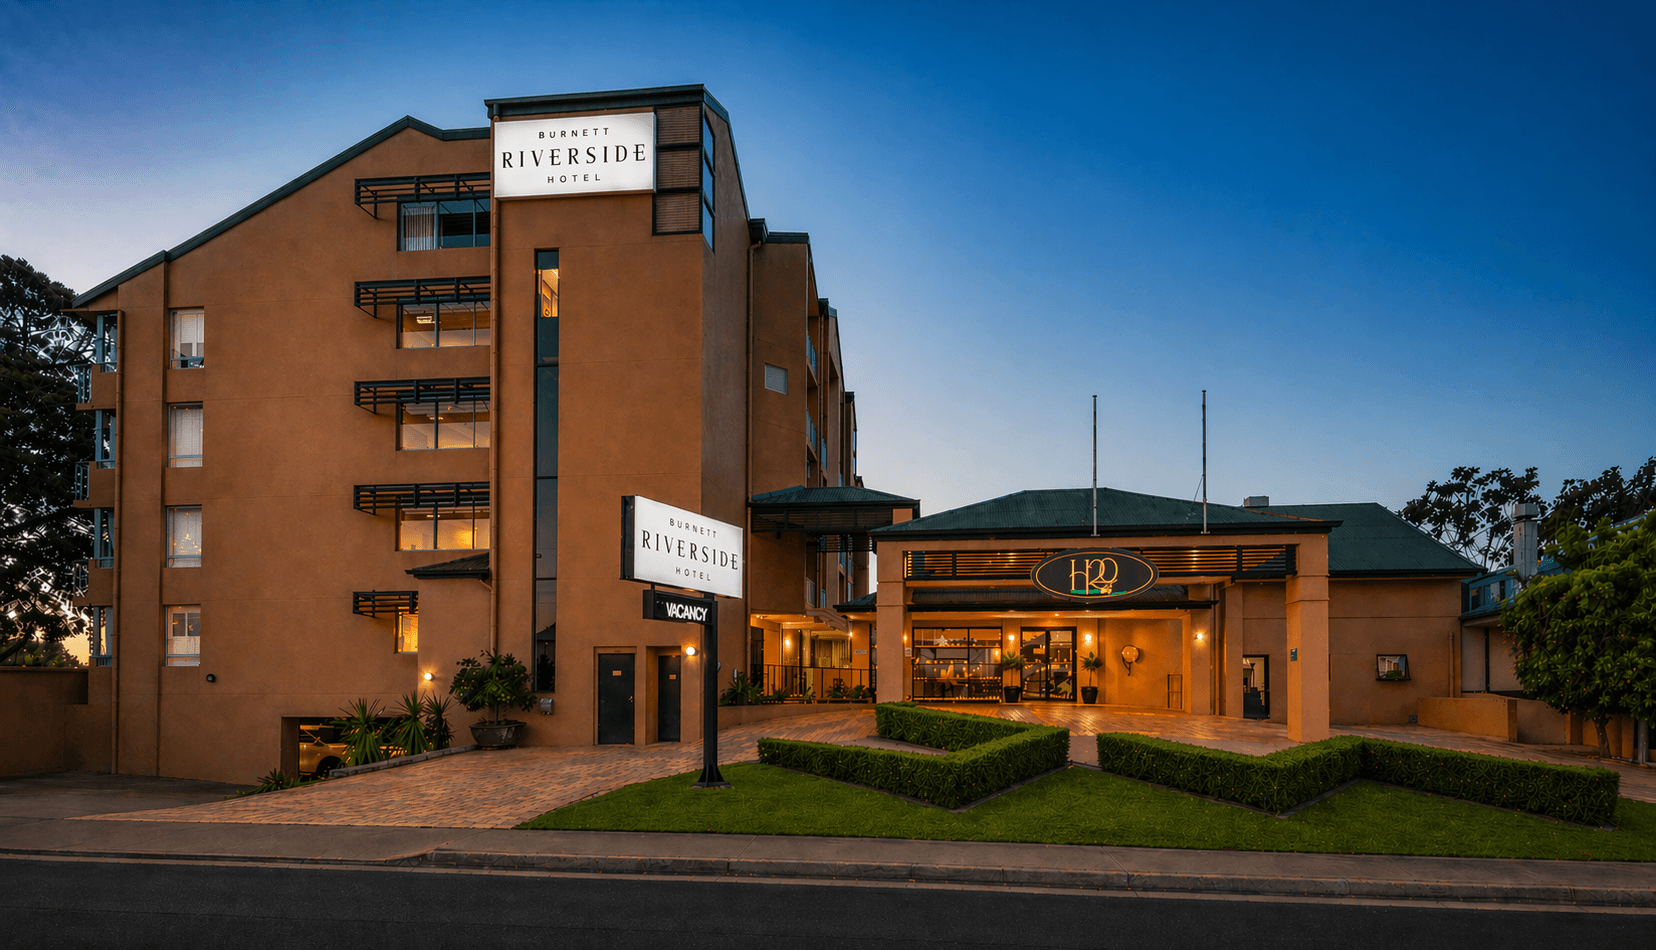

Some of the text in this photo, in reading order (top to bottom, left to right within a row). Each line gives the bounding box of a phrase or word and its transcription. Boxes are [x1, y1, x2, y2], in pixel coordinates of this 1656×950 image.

[538, 127, 609, 139] BURNETT
[501, 143, 646, 169] RIVERSIDE
[547, 173, 601, 184] HOTEL
[669, 518, 717, 538] BURNETT
[641, 529, 739, 571] RIVERSIDE
[675, 566, 711, 581] HOTEL
[665, 601, 708, 622] VACANCY
